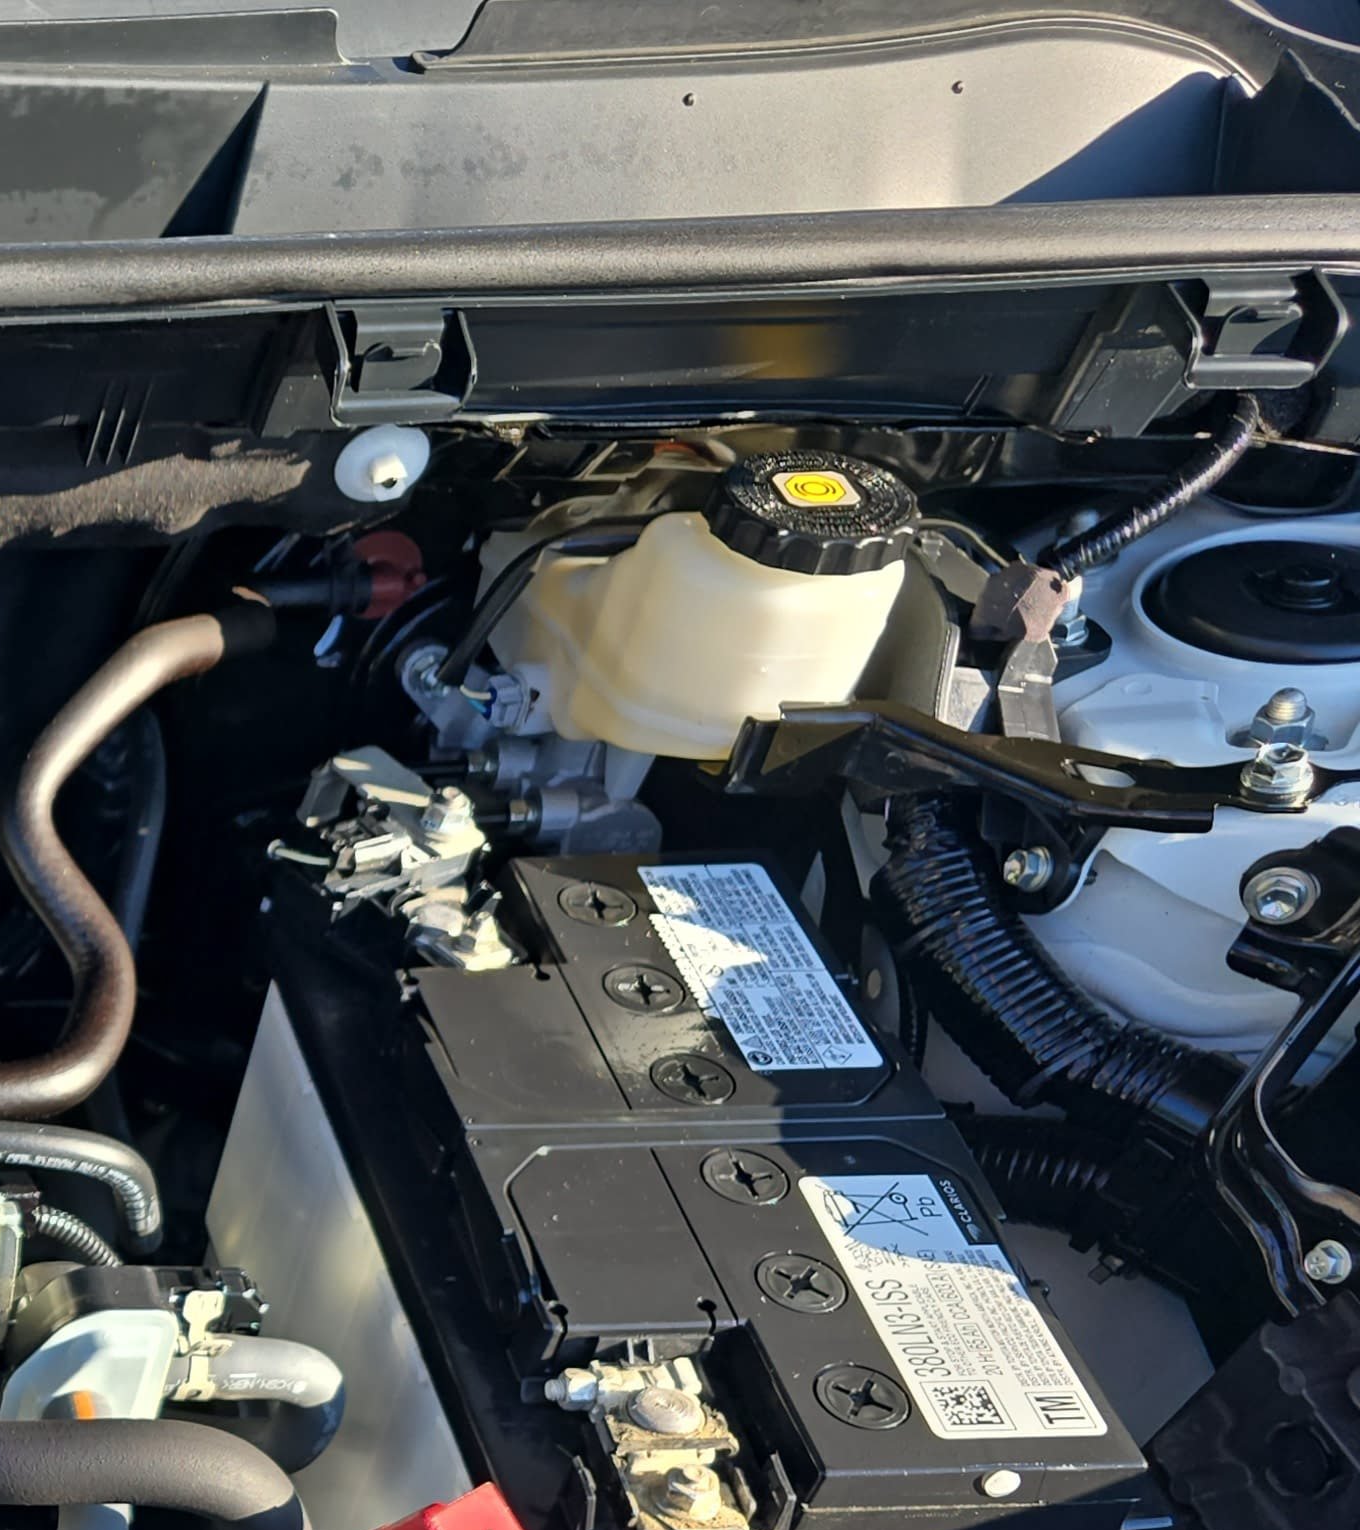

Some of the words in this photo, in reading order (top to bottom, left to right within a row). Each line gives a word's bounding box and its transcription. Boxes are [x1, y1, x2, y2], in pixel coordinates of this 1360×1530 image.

[916, 1196, 944, 1218] Pb
[939, 1179, 972, 1223] CLARIOS
[865, 1278, 952, 1377] 380LN3-ISS
[1033, 1395, 1086, 1424] TM
